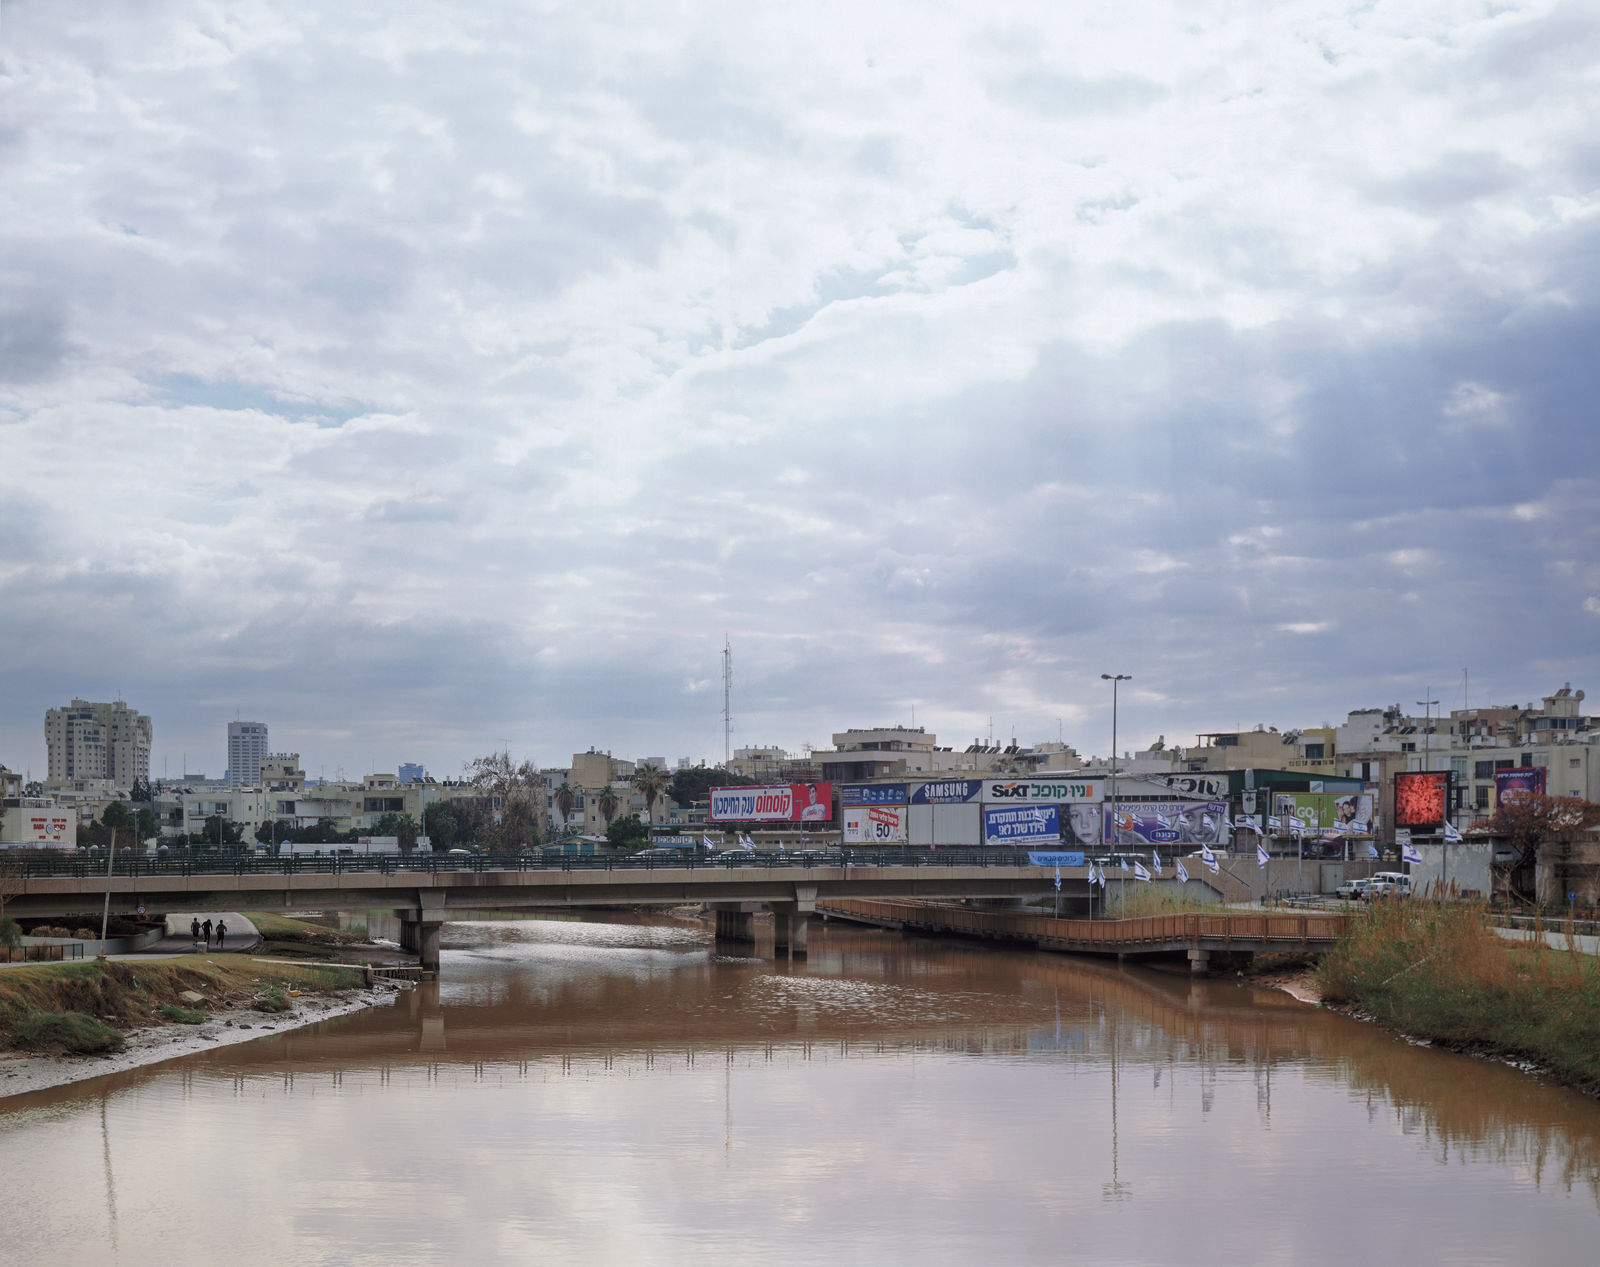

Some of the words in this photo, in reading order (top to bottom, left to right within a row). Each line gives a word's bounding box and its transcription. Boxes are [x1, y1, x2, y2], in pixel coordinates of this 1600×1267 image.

[925, 783, 968, 797] SAMSUNG
[741, 797, 755, 816] ענק
[877, 824, 890, 838] 50
[1012, 823, 1028, 835] שלך
